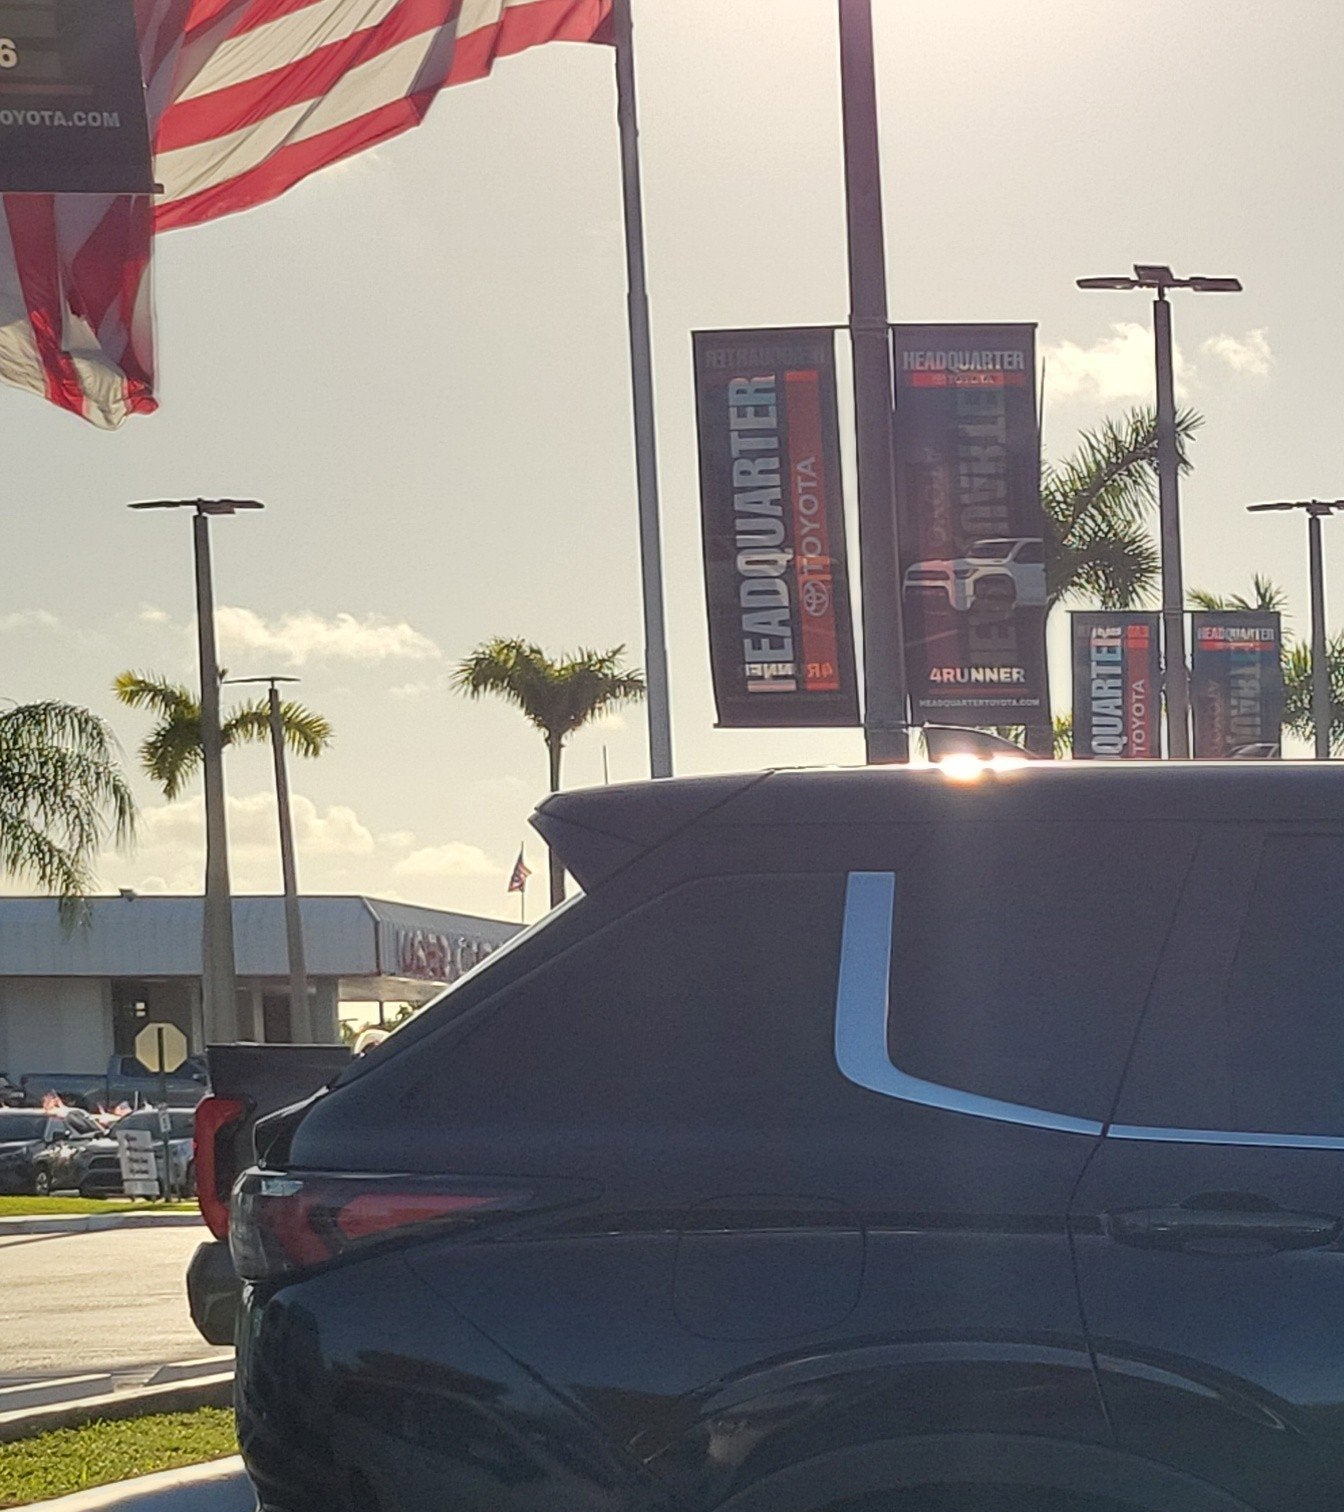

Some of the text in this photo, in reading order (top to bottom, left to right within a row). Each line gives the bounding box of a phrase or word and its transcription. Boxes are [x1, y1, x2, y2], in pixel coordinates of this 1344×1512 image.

[903, 351, 1025, 372] HEADQUARTER
[729, 374, 797, 692] HEADQUARTER
[796, 456, 823, 573] TOYOTA
[930, 667, 1025, 683] 4RUNNER
[1131, 679, 1146, 757] TOYOTA
